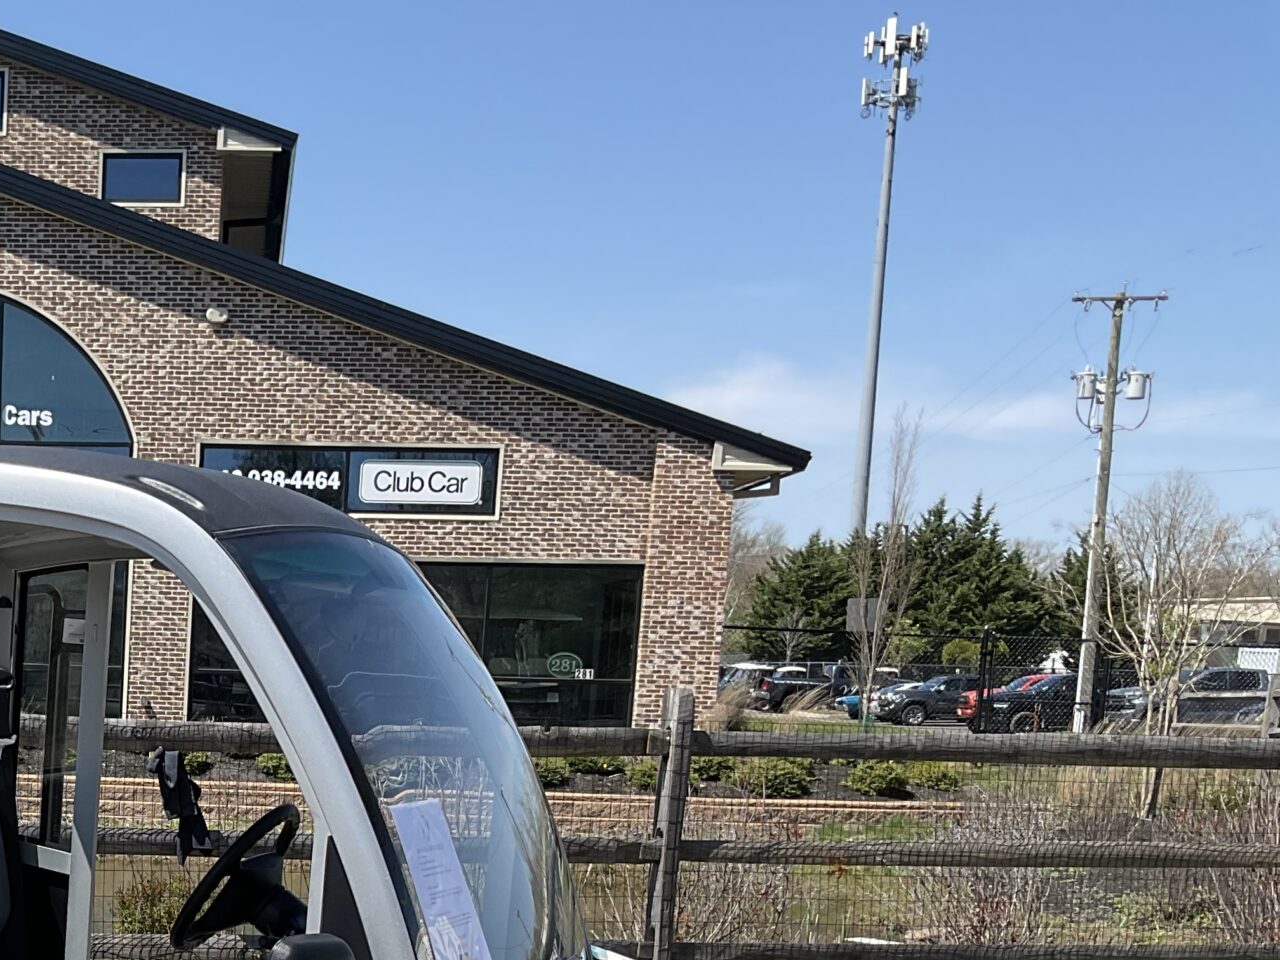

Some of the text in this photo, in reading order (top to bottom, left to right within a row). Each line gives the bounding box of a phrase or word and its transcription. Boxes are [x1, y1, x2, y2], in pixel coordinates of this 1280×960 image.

[4, 405, 53, 427] Cars
[374, 470, 469, 493] Club Car
[551, 658, 576, 673] 281
[576, 670, 593, 679] 281
